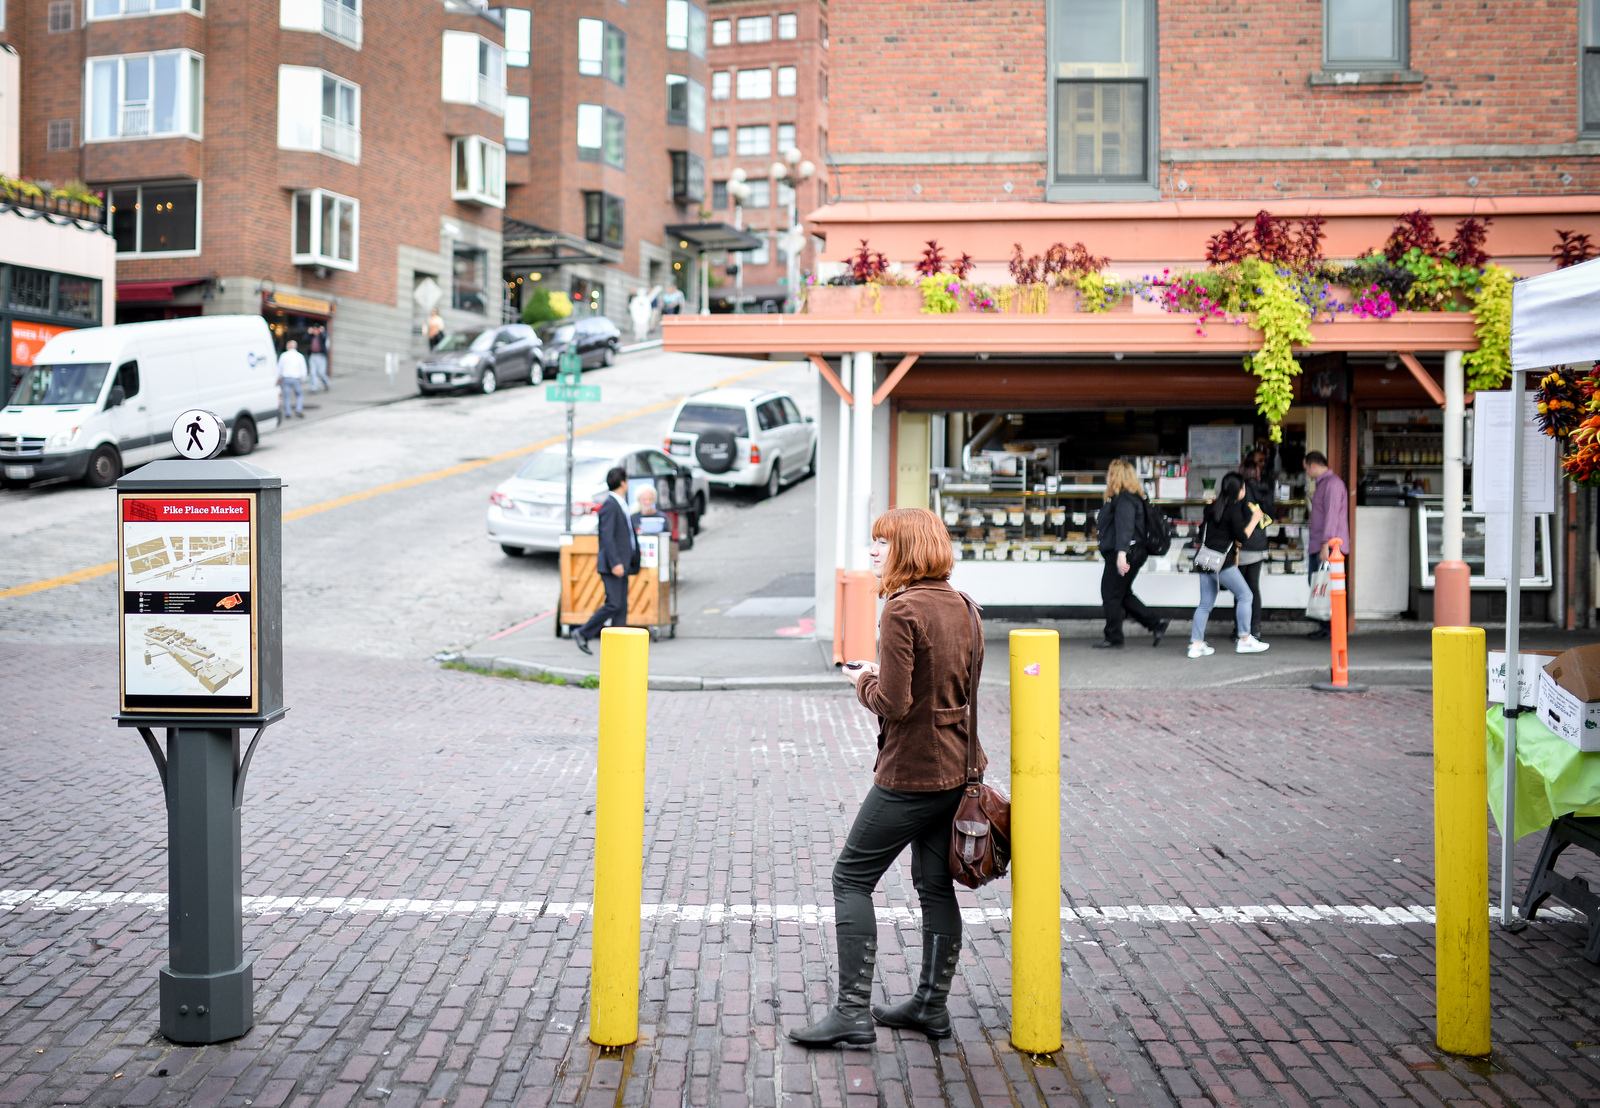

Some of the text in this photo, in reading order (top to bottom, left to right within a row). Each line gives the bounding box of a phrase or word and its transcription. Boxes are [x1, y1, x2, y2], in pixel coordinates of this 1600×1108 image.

[163, 505, 244, 514] Pike Place Market
